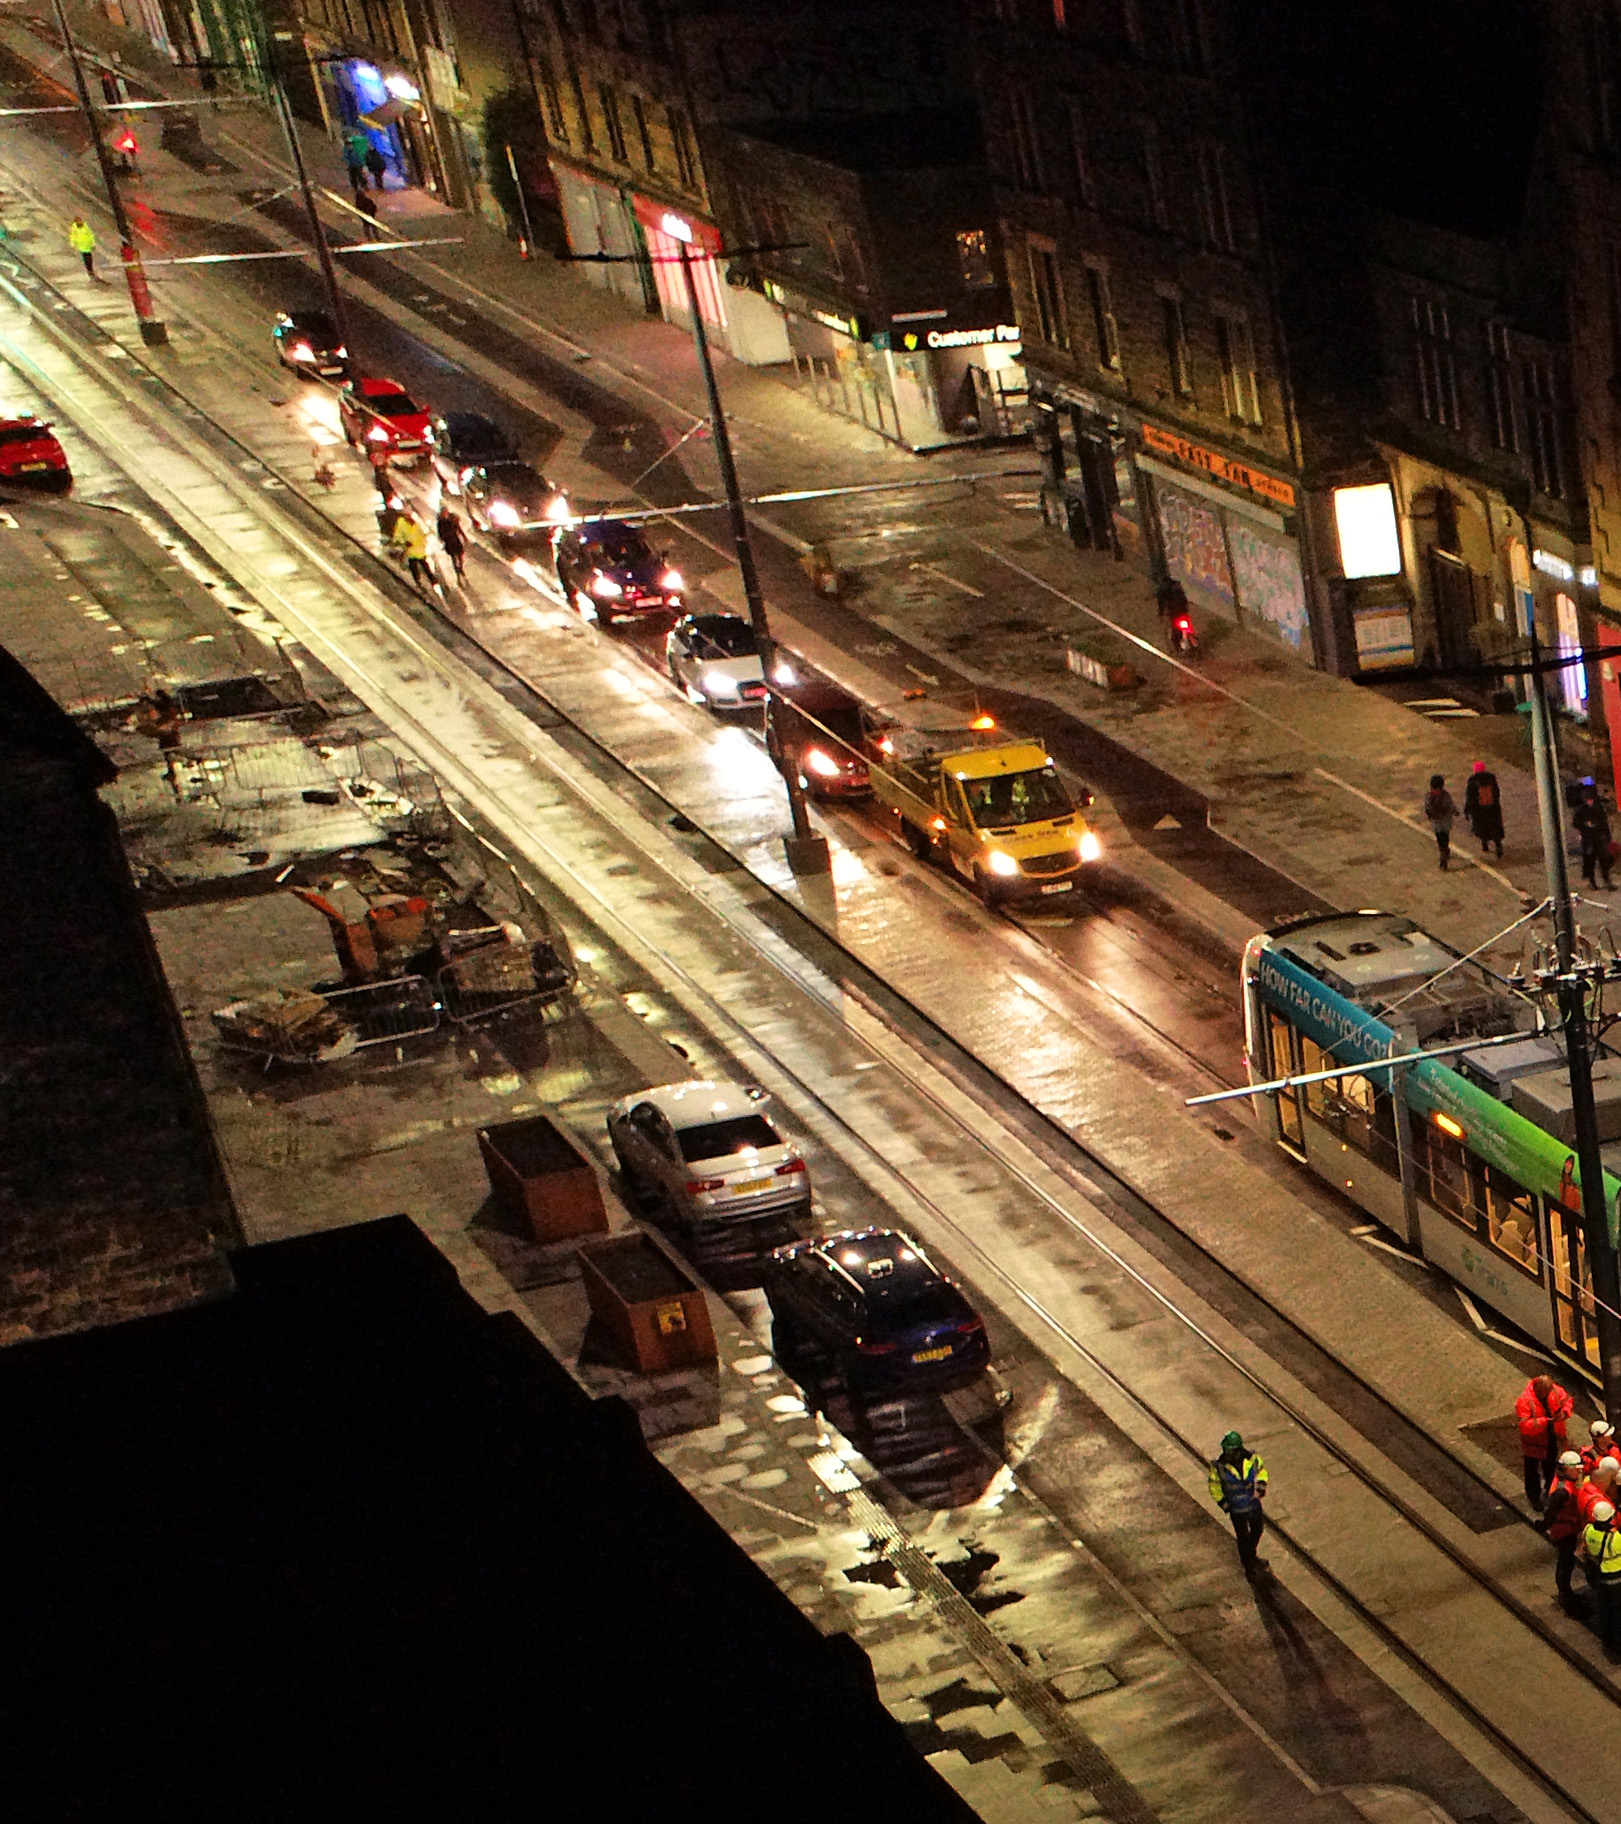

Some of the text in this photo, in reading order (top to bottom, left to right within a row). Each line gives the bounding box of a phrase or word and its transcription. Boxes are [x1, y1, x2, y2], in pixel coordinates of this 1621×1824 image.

[927, 328, 995, 348] Customer
[1261, 961, 1289, 998] HOW
[1290, 980, 1311, 1015] FAR
[1312, 997, 1337, 1031] CAN
[1337, 1013, 1363, 1048] YOU
